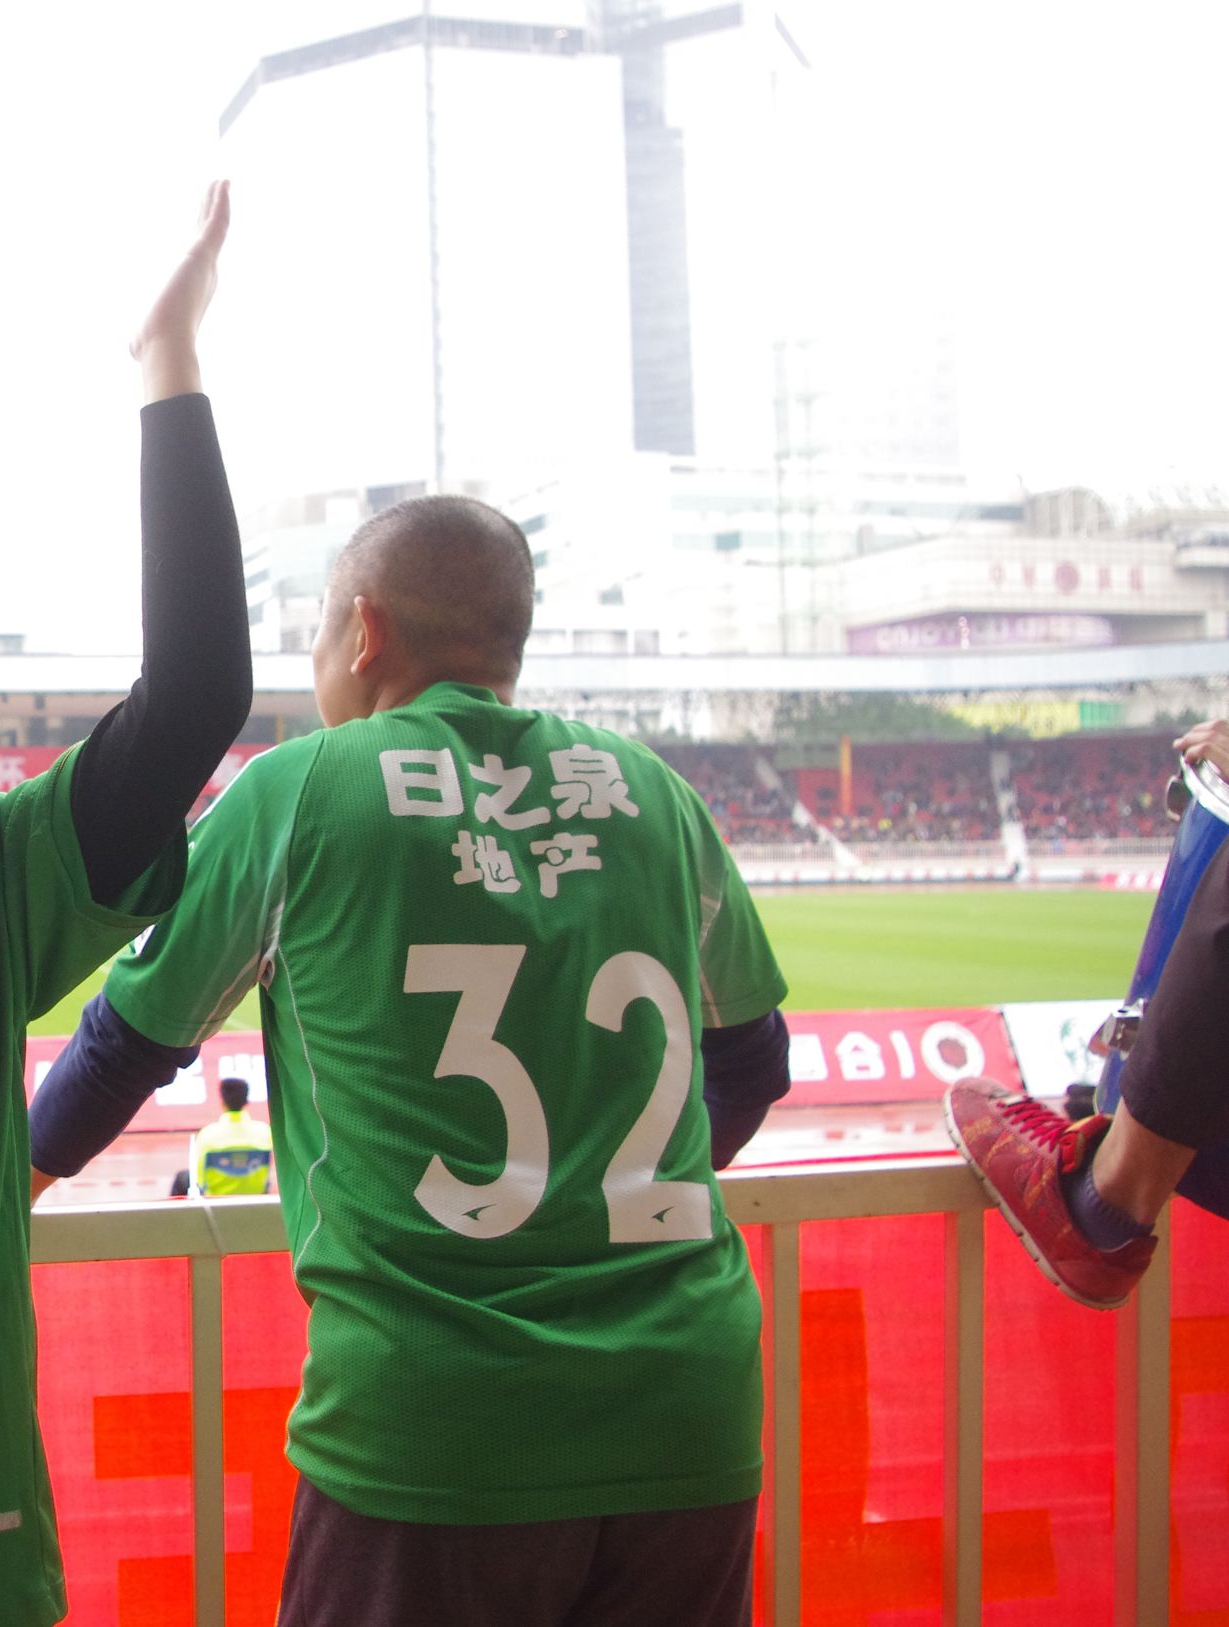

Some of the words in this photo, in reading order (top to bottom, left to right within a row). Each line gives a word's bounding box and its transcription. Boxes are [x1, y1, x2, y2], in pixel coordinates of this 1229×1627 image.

[379, 744, 639, 830] 日之泉
[452, 830, 602, 898] 地产
[403, 944, 713, 1243] 32
